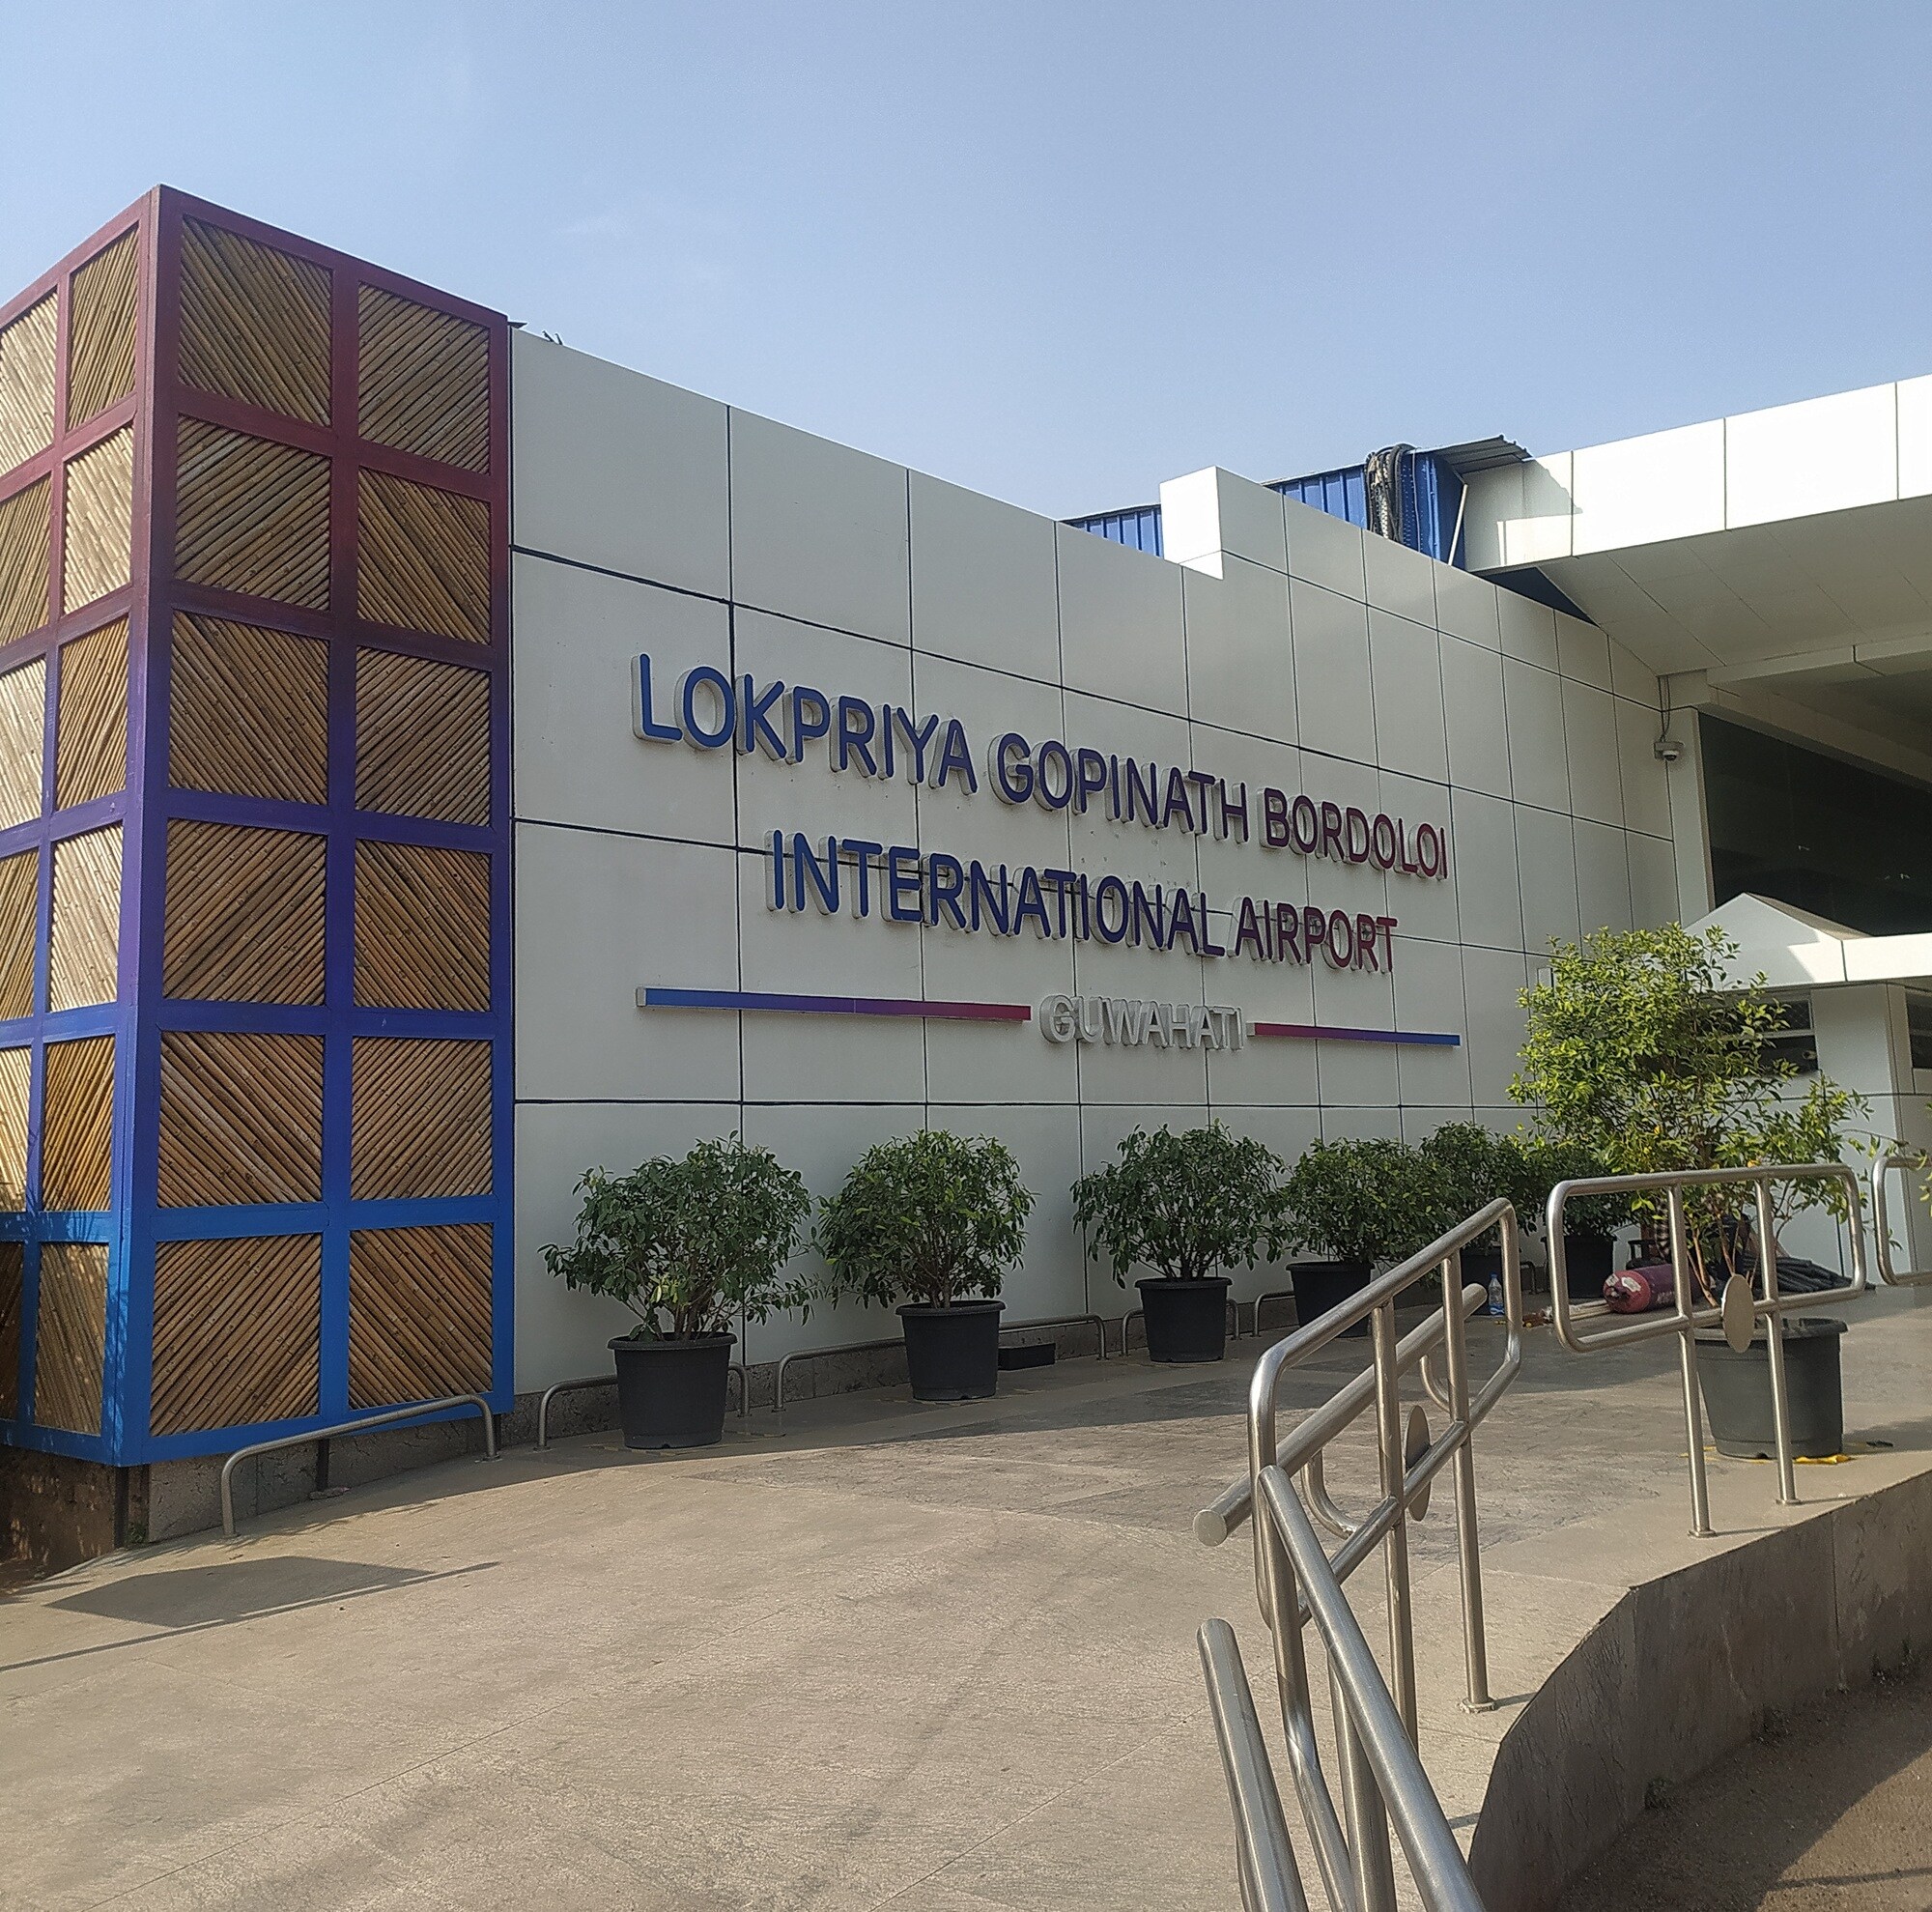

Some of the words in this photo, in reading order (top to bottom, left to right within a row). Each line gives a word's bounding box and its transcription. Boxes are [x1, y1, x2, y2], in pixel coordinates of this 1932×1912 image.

[635, 653, 978, 794] LOKPRIYA
[990, 732, 1249, 842] GOPINATH
[1260, 787, 1449, 879] BORDOLOI
[766, 829, 1226, 957] INTERNATIONAL
[1231, 897, 1398, 972] AIRPORT
[1040, 994, 1244, 1050] GUWAHATI
